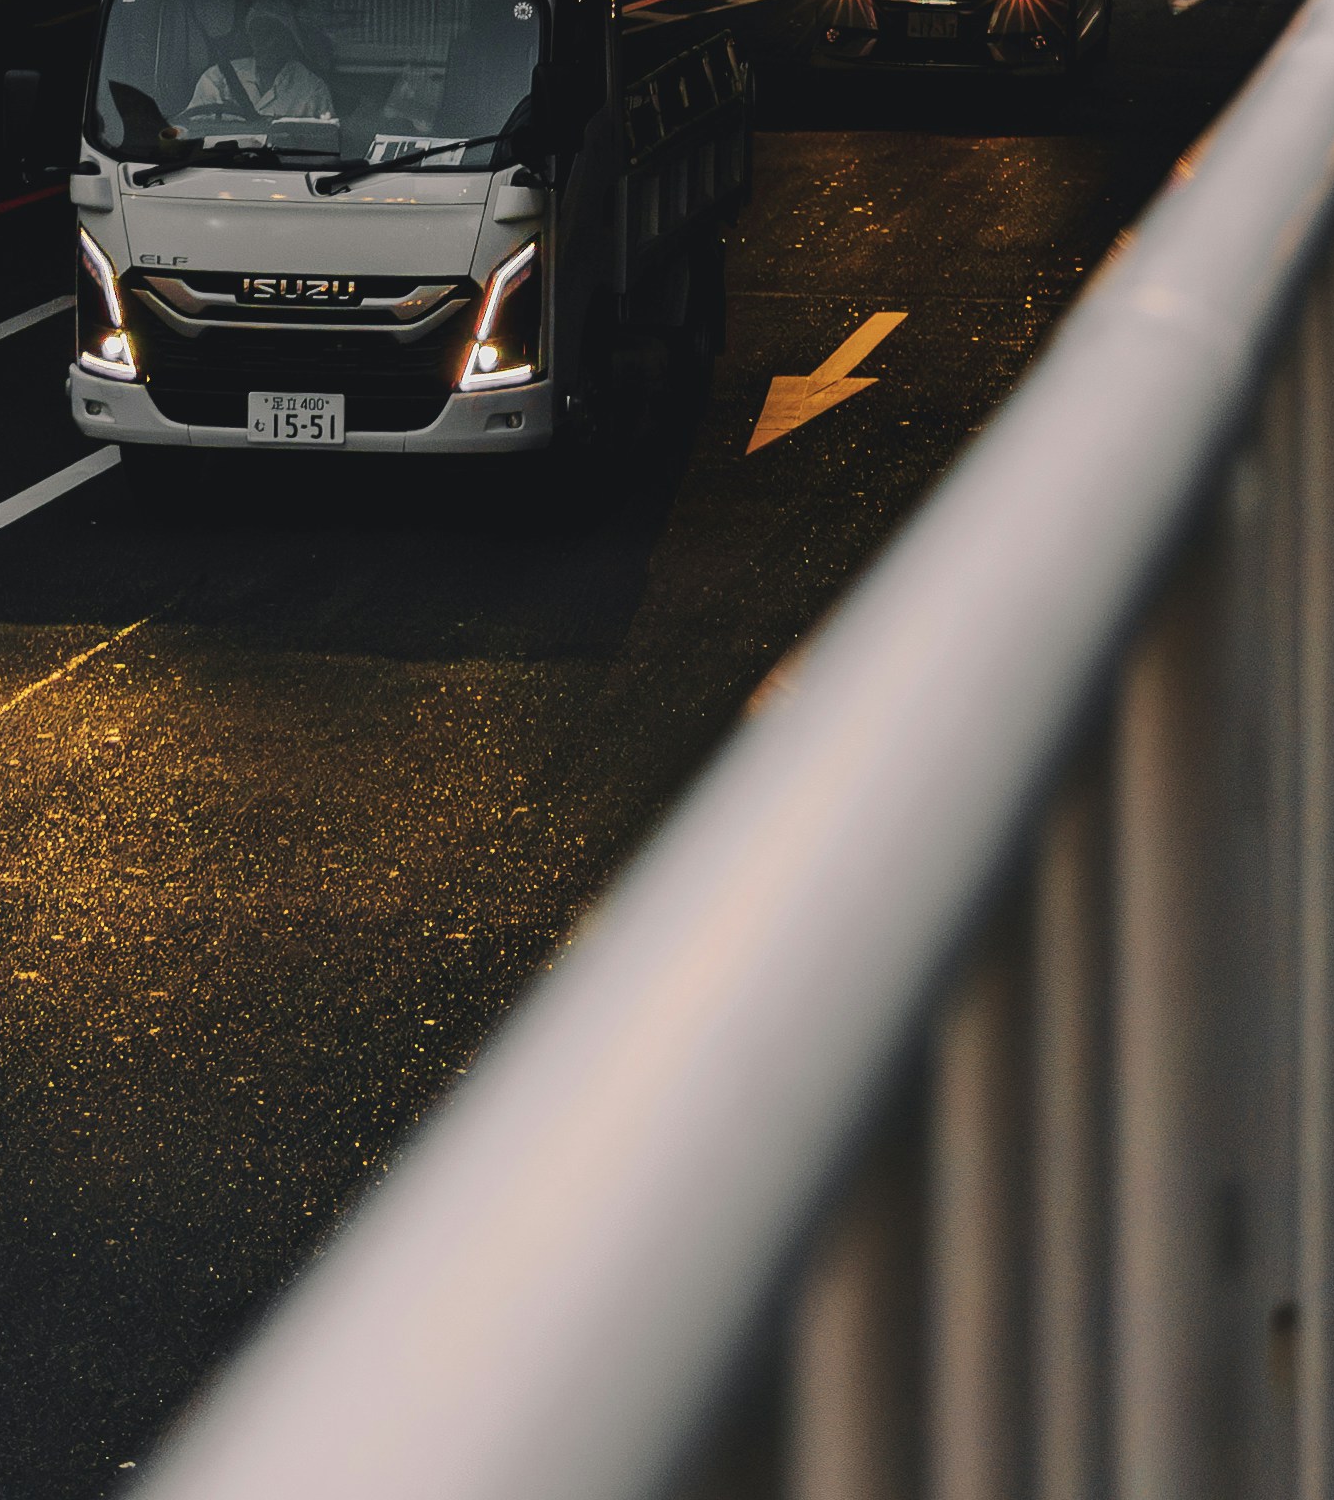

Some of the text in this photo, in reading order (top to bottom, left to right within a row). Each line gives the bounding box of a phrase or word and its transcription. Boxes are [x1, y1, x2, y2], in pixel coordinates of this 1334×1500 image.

[139, 254, 189, 266] ELF
[243, 278, 355, 300] ISUZU
[271, 396, 325, 411] 足立 400
[273, 413, 336, 440] 15-51
